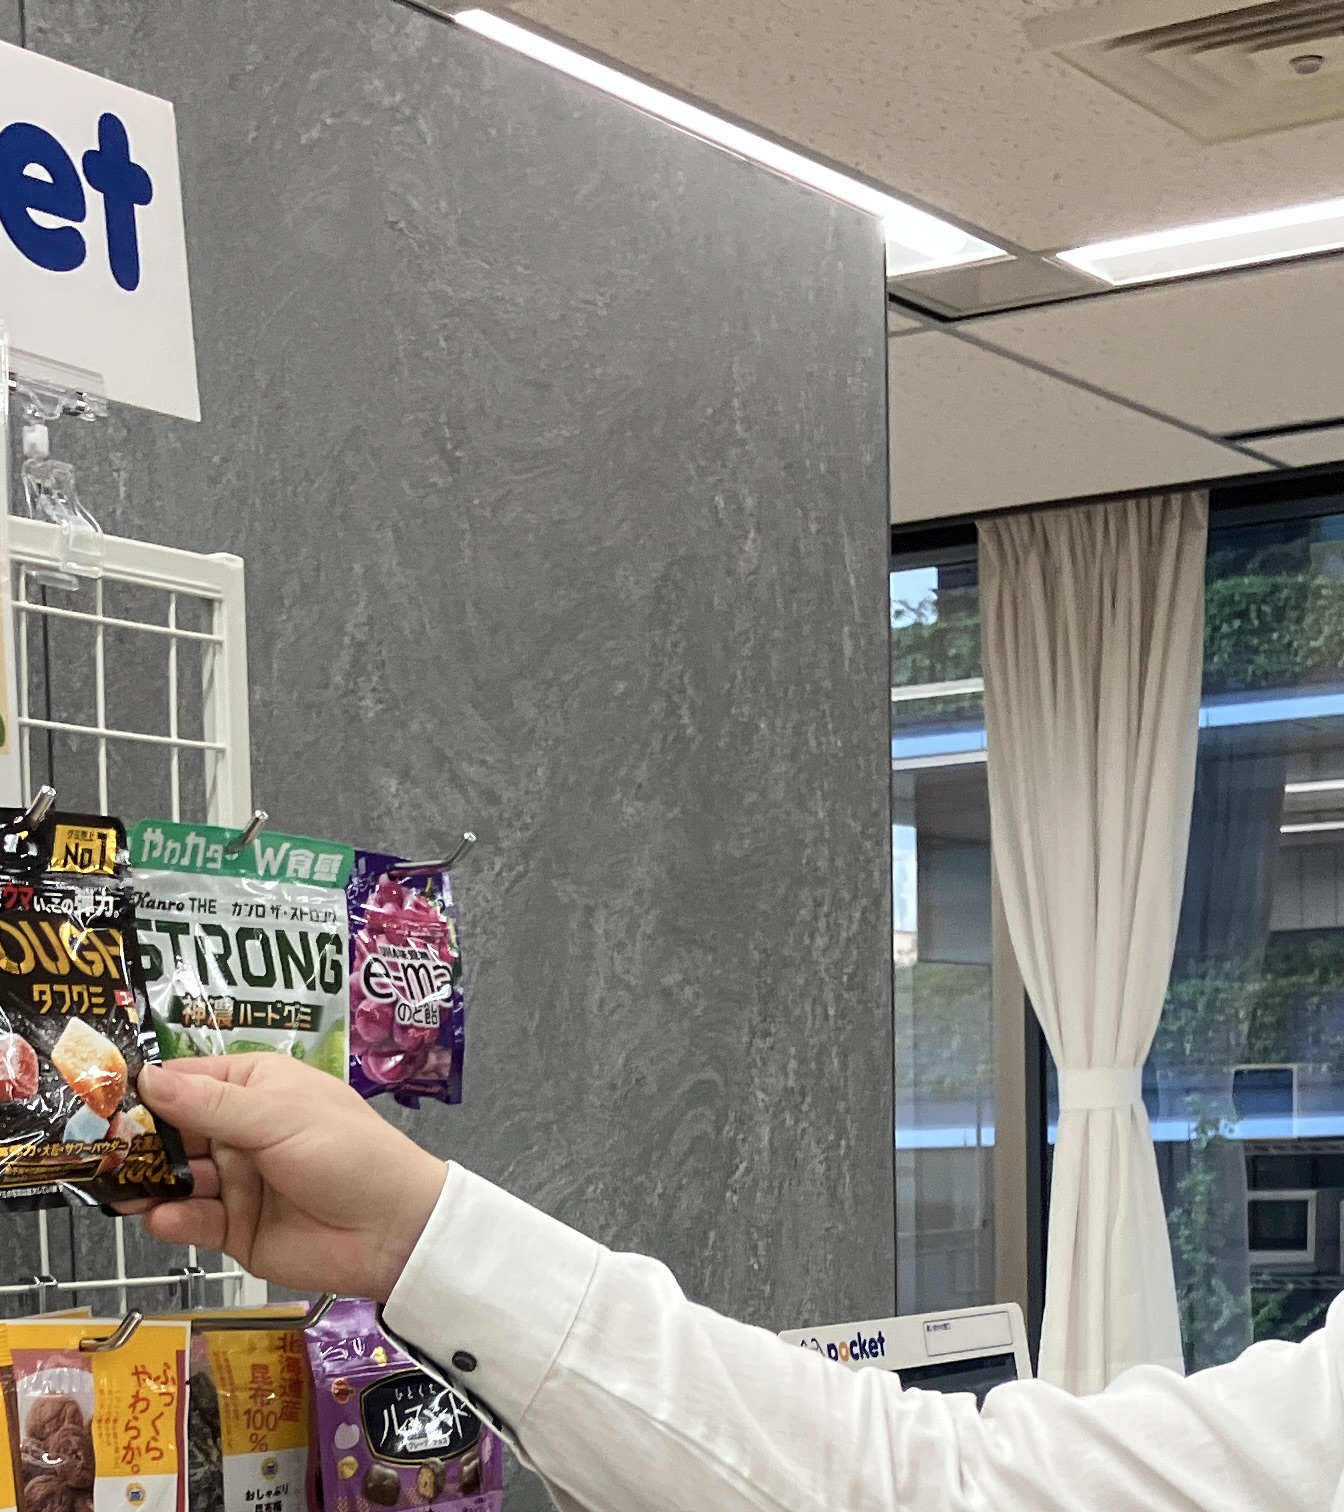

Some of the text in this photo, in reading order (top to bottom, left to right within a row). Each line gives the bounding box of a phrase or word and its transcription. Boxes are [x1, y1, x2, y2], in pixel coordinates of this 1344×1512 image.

[188, 898, 218, 916] THE
[230, 901, 267, 920] カンロ
[134, 916, 344, 996] STRONG
[826, 1330, 886, 1362] pocket
[121, 1363, 152, 1476] やわらか。
[144, 1361, 178, 1462] ふっくら
